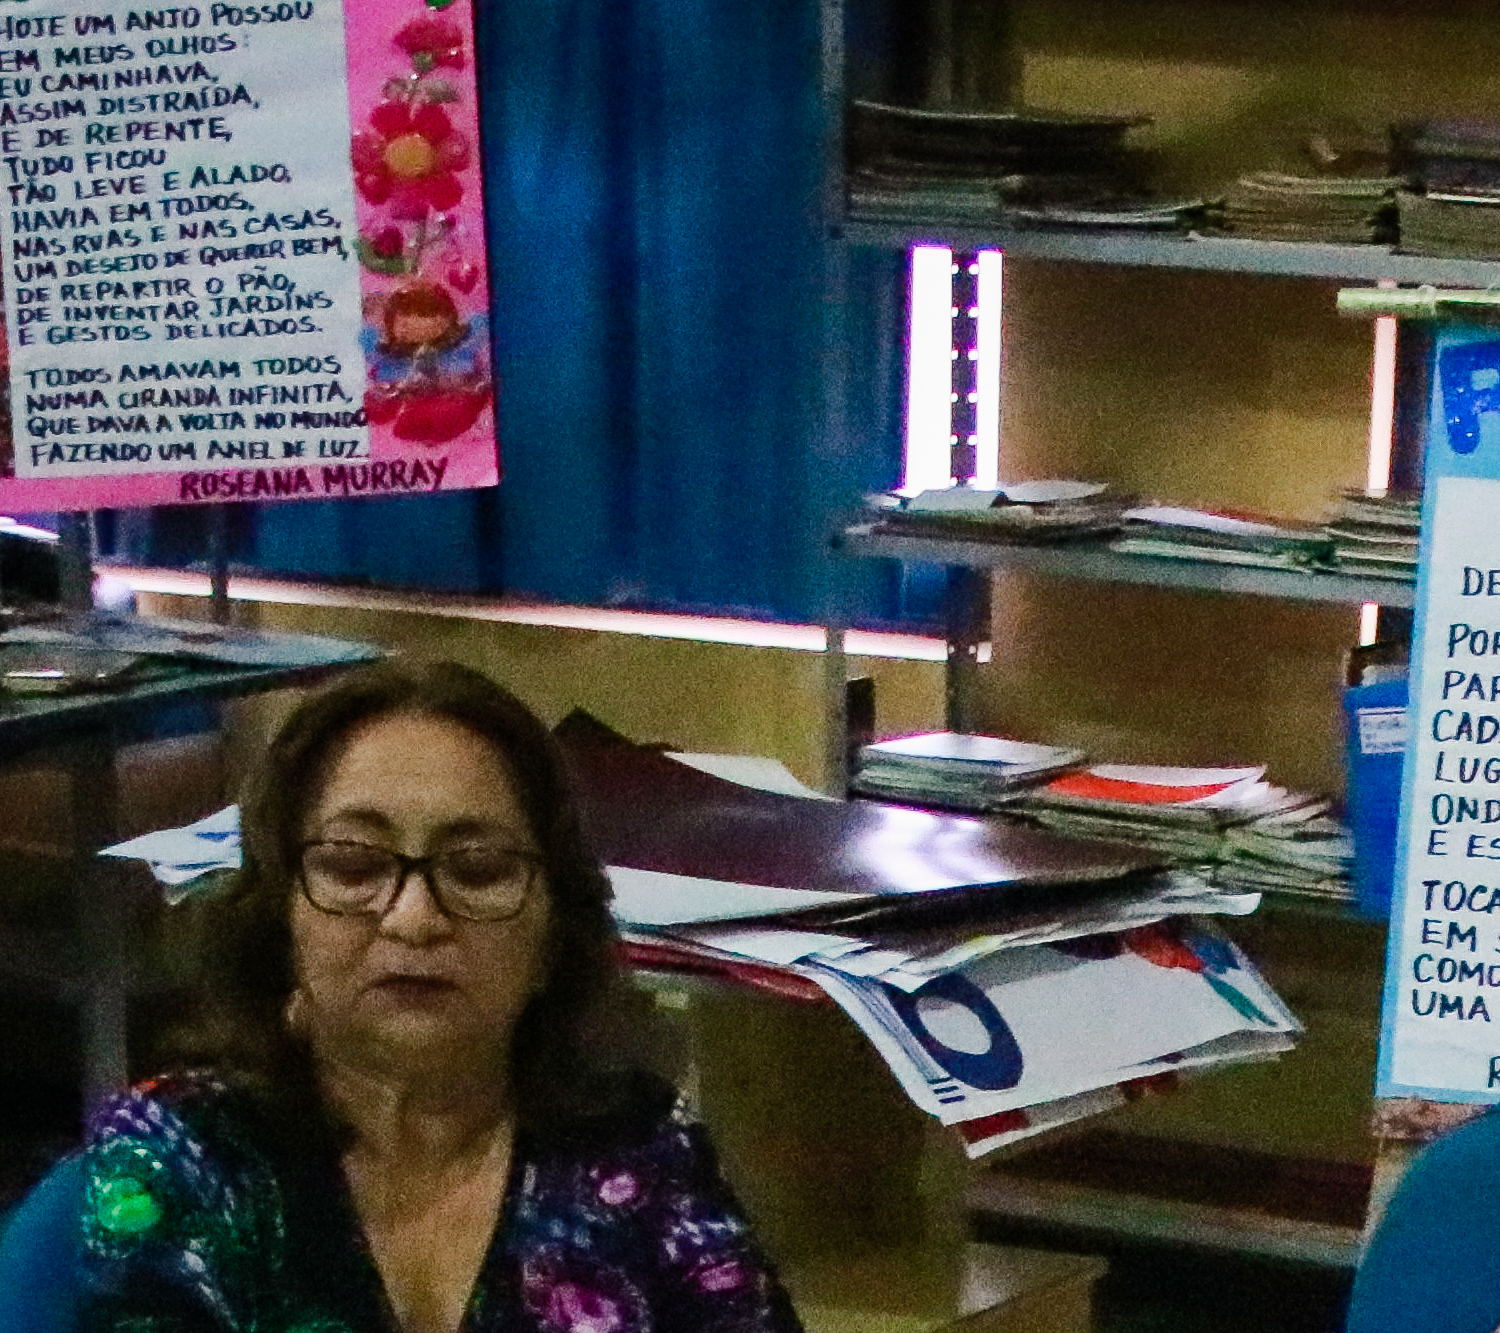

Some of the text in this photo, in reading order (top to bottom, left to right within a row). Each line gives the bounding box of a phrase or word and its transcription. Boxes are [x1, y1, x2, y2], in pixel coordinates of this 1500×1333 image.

[74, 15, 116, 36] UM
[125, 8, 201, 31] ANJO
[55, 44, 135, 67] MEUS
[0, 99, 87, 126] ASSIM
[2, 116, 233, 153] E DE REPENTE,
[3, 149, 167, 183] TUDO FICOU
[8, 176, 56, 206] TÃO
[75, 175, 147, 200] LEVE
[163, 171, 181, 191] E
[11, 207, 100, 233] HAVIA
[110, 201, 151, 223] EM
[12, 237, 66, 260] NAS
[73, 228, 142, 254] RUAS
[152, 226, 166, 243] E
[178, 219, 237, 240] NAS
[14, 261, 58, 282] UM
[66, 253, 158, 277] DESEJO
[163, 249, 189, 267] DE
[292, 235, 348, 261] BEM,
[16, 287, 50, 305] DE
[61, 278, 191, 302] REPARTIR
[205, 277, 224, 294] O
[17, 307, 51, 325] DE
[64, 301, 199, 322] INVENTAR
[18, 316, 322, 346] E GESTOS DELICADOS.
[25, 355, 341, 389] TODOS AMAVAM TODOS
[26, 390, 109, 413] NUMA
[118, 386, 221, 409] CIRANDA
[26, 407, 368, 438] QUE DAVA A VOLTA NO MUNDO
[31, 443, 152, 466] FAZENDO
[158, 443, 197, 461] UM
[207, 441, 275, 460] ANEL
[180, 456, 448, 500] ROSEANA MURRAY
[1427, 829, 1448, 856] E
[1421, 919, 1476, 953] EM
[1411, 989, 1491, 1023] UMA
